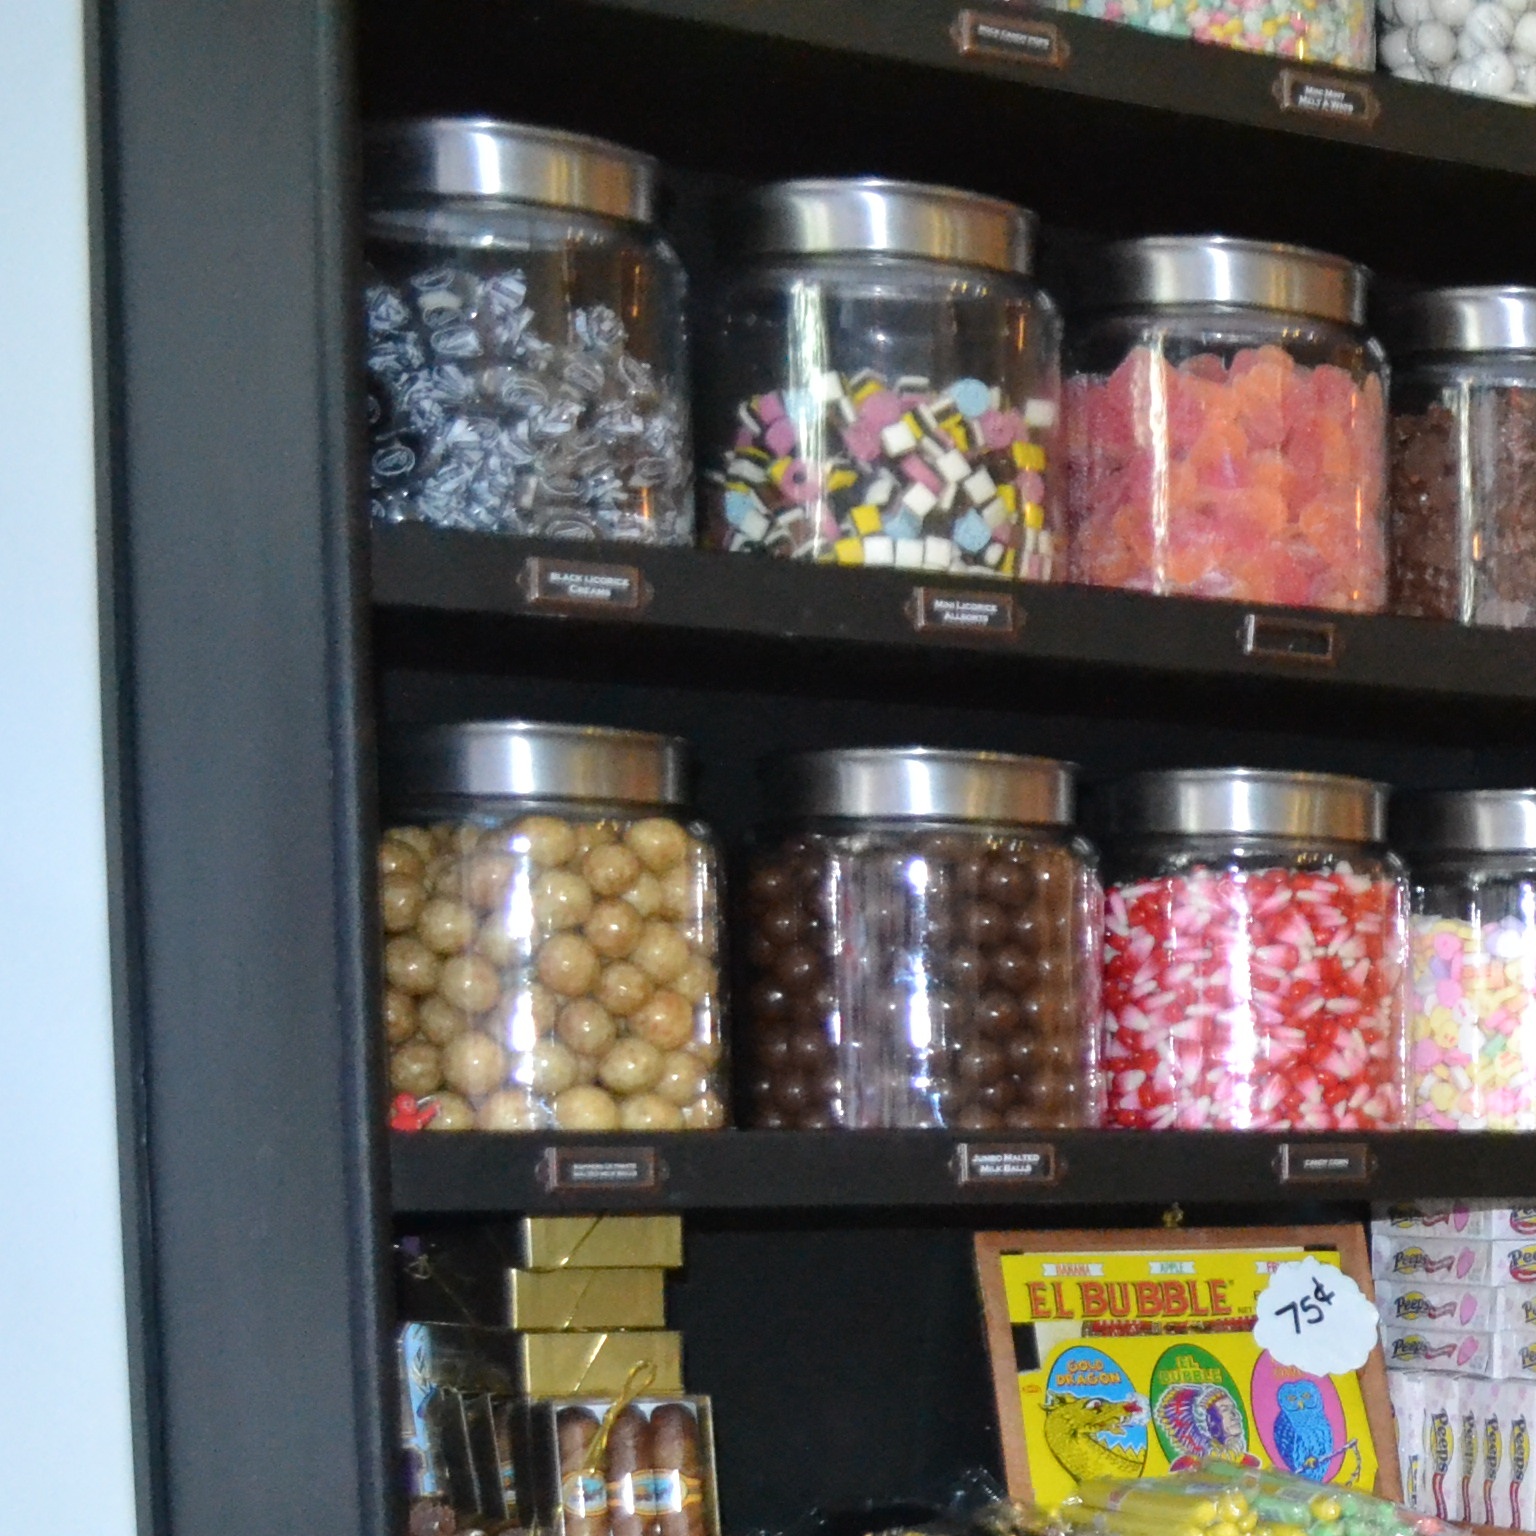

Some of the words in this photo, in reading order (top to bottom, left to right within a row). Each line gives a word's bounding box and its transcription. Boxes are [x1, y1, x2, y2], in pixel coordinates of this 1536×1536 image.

[1028, 1280, 1073, 1320] EL
[1080, 1278, 1232, 1318] BUBBLE
[1067, 1360, 1105, 1374] GOLD
[1055, 1371, 1122, 1387] DRAGON
